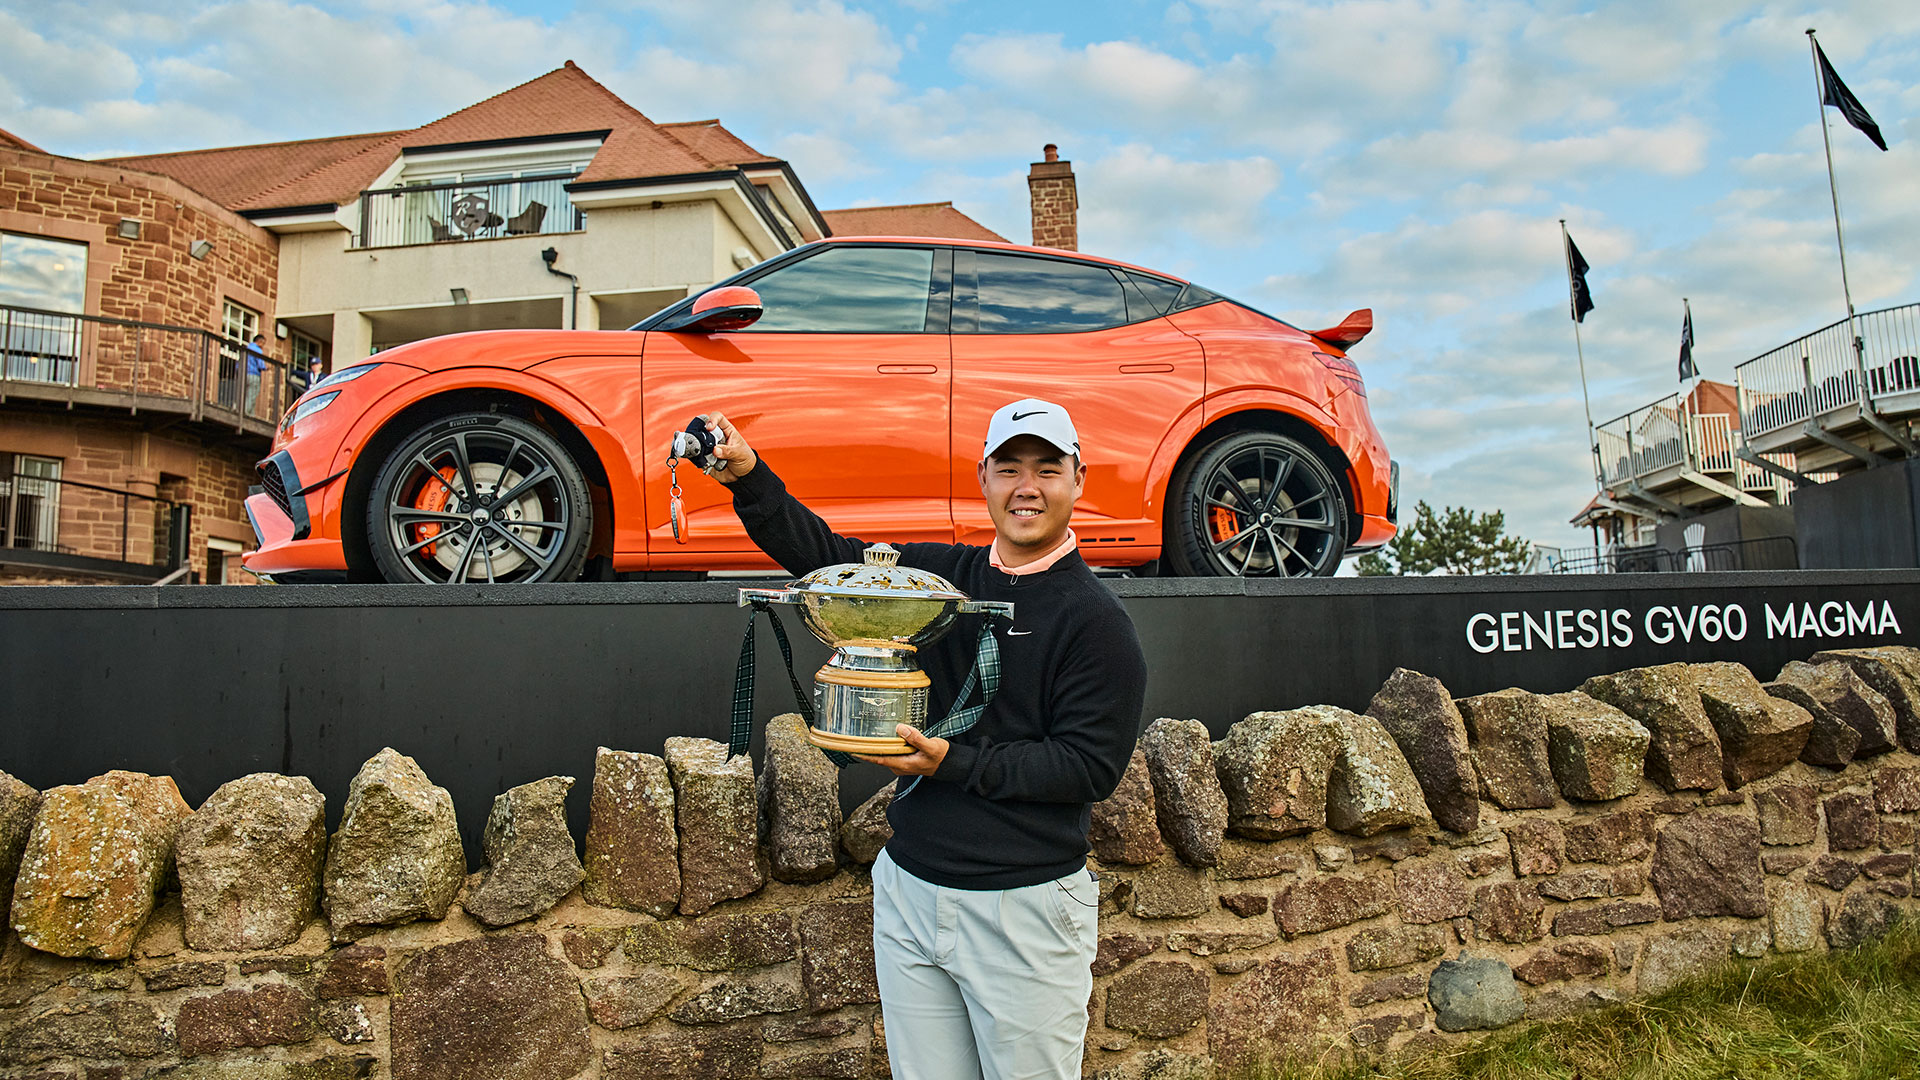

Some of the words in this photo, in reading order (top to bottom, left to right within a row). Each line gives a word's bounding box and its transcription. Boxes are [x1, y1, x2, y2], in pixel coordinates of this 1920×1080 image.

[1466, 608, 1633, 653] GENESIS
[1644, 603, 1748, 644] GV60
[1764, 599, 1902, 640] MAGMA
